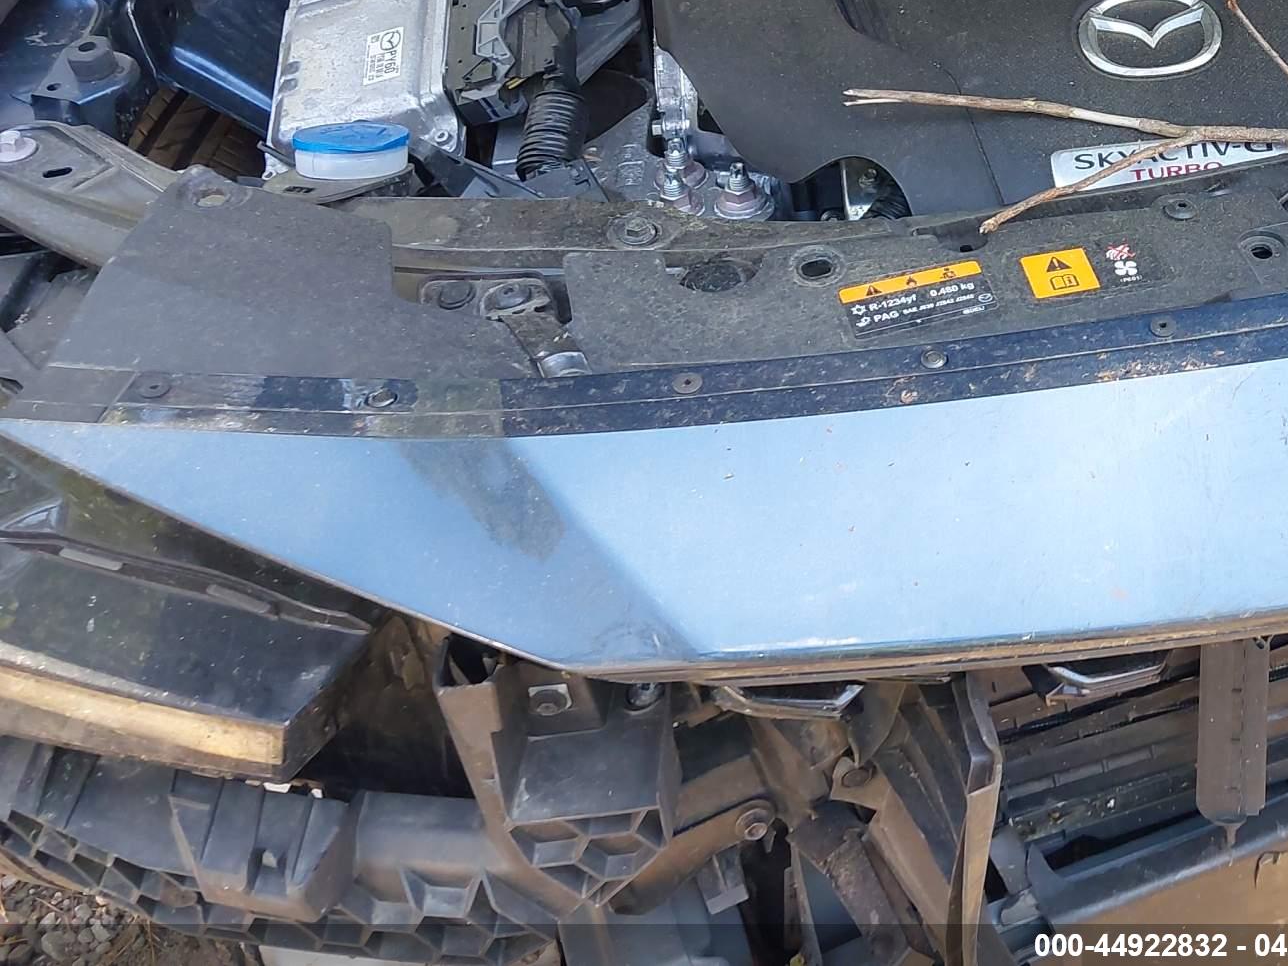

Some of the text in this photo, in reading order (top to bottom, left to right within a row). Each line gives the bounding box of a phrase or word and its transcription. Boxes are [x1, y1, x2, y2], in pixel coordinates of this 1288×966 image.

[1132, 162, 1222, 181] TURBO
[868, 293, 917, 312] R-1234yf
[960, 281, 975, 291] kg
[873, 309, 900, 323] PAG
